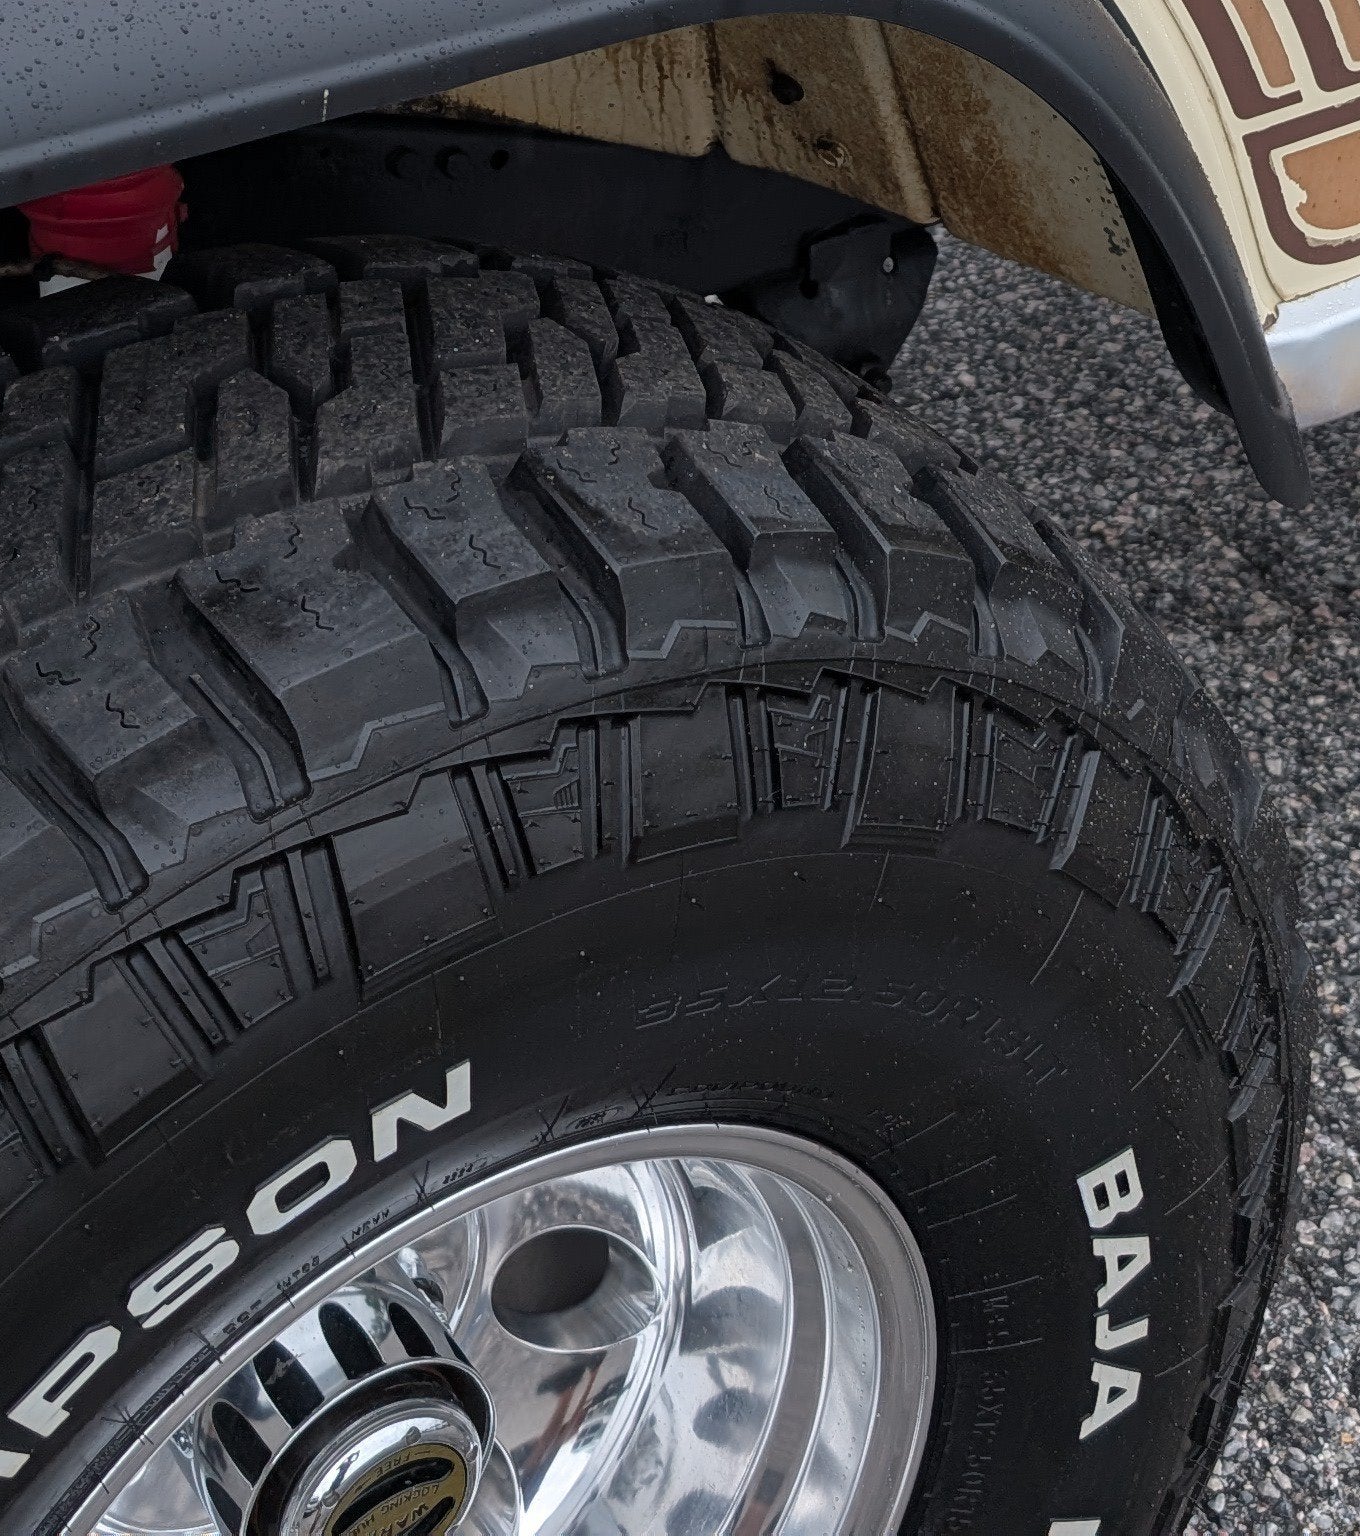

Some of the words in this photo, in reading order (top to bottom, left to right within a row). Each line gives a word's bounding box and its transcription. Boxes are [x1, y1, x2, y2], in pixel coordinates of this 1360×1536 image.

[1077, 1147, 1151, 1440] BAJA
[375, 1452, 410, 1476] FREE
[381, 1485, 439, 1515] LOCKING
